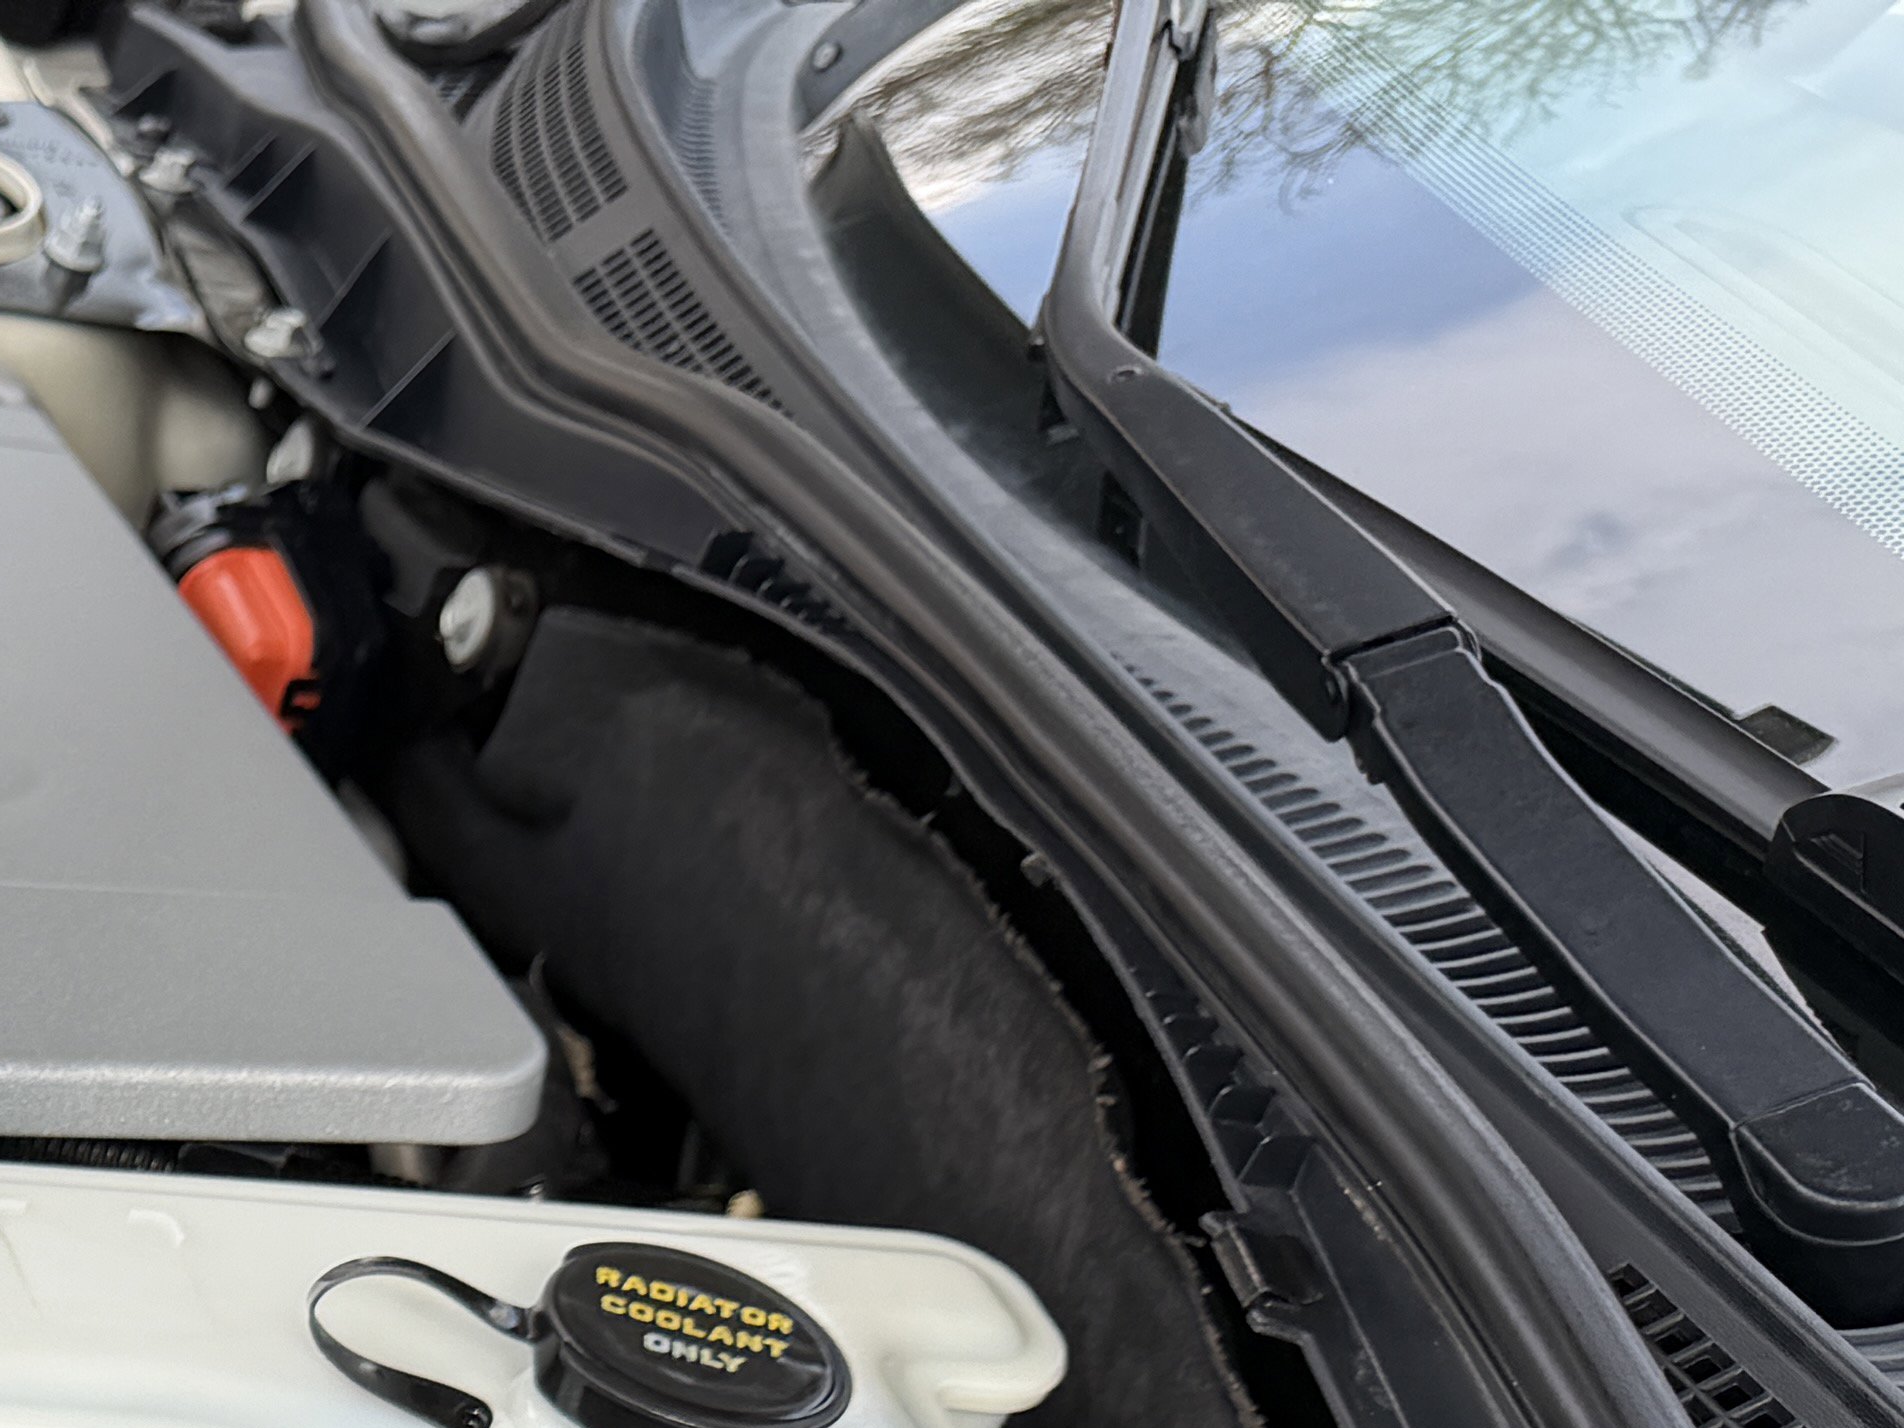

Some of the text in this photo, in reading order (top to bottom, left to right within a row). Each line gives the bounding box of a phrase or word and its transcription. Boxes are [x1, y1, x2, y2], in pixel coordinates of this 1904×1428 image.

[596, 1266, 793, 1334] RADIATOR
[601, 1294, 789, 1358] COOLANT
[644, 1332, 747, 1373] ONLY
